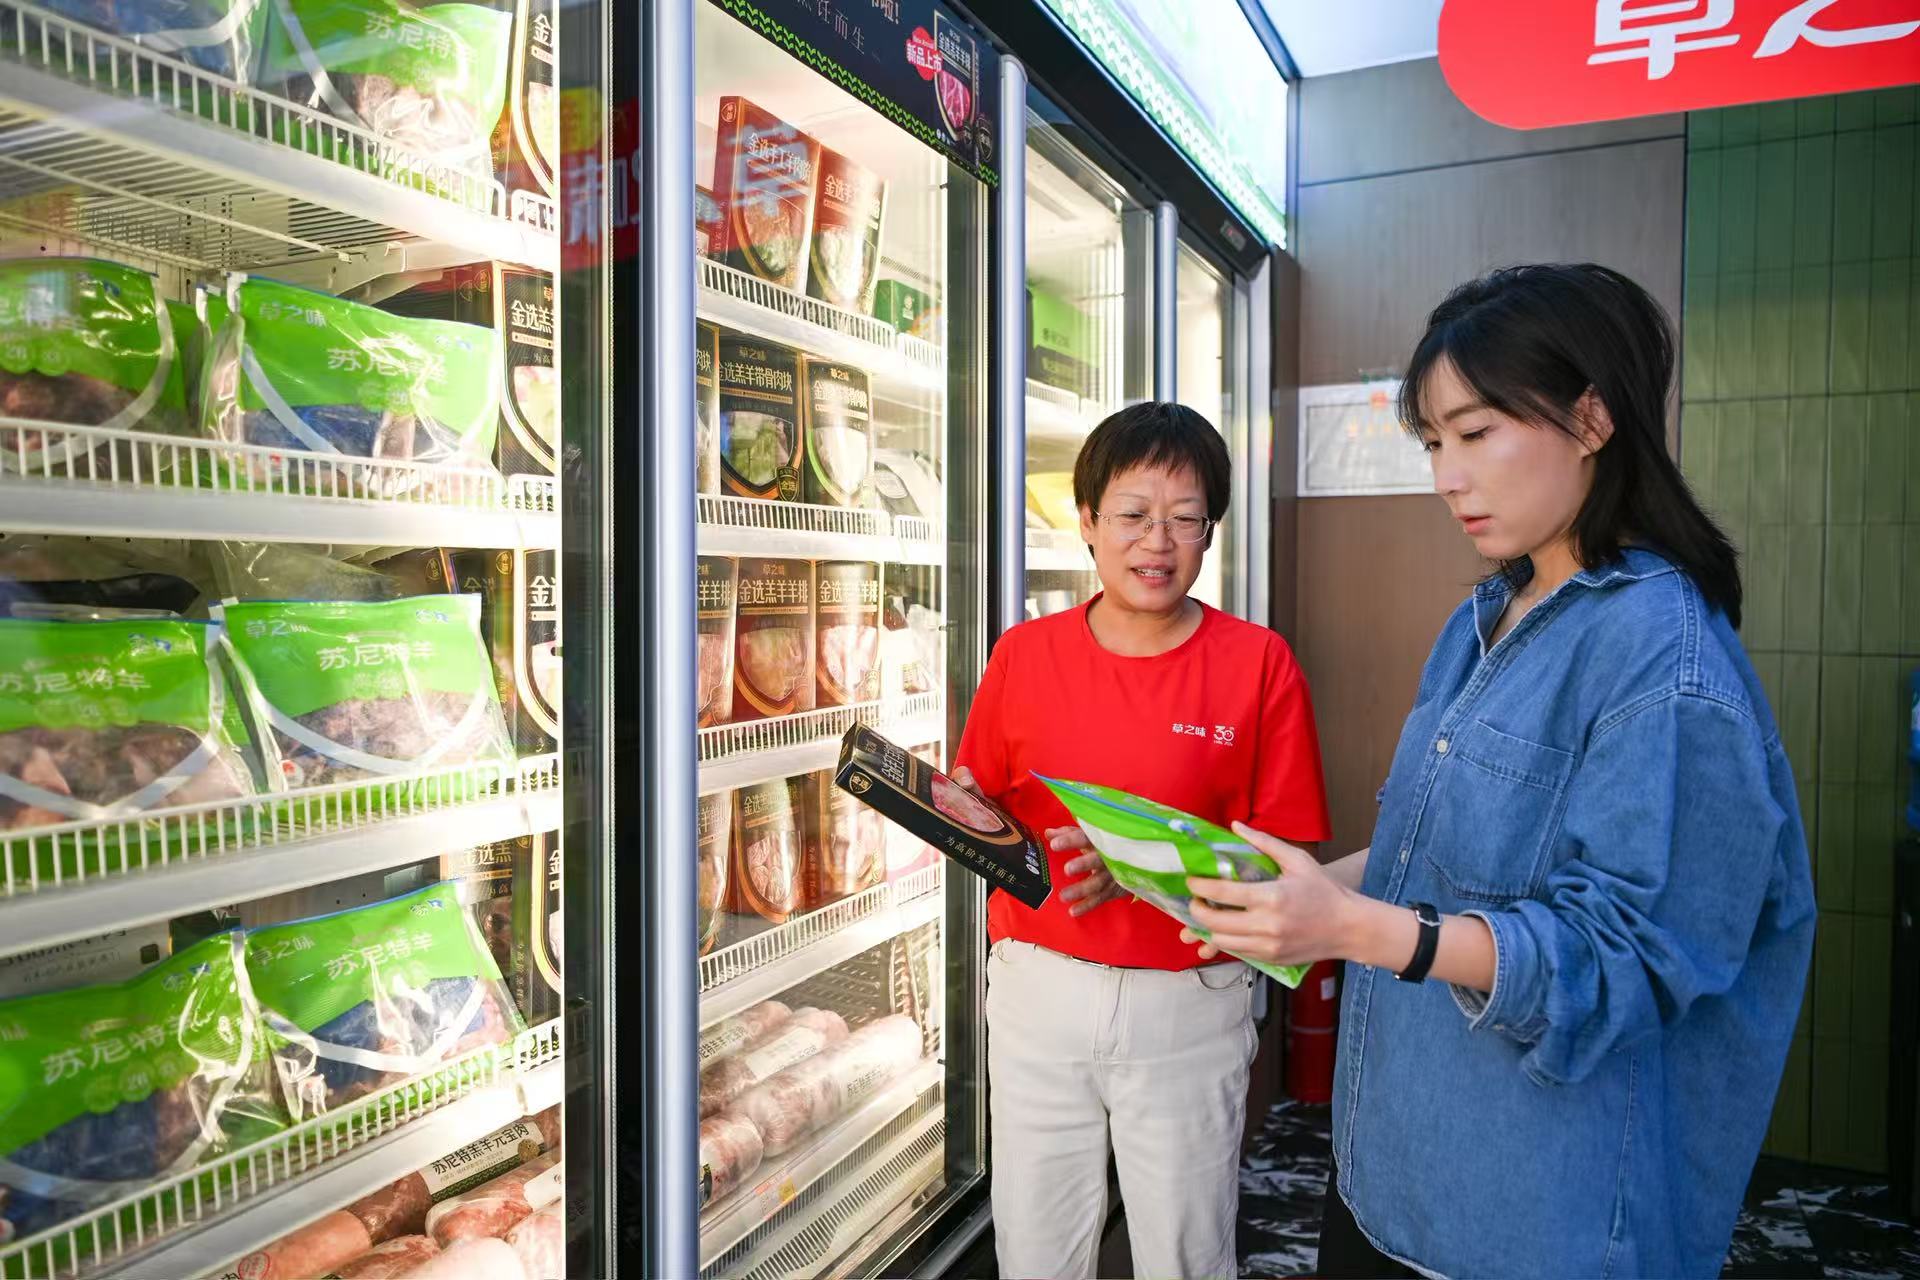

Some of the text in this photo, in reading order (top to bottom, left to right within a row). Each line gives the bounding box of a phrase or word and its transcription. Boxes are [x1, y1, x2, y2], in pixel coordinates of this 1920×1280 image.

[797, 0, 864, 55] 饪而生
[872, 0, 899, 24] 啦!
[906, 44, 943, 72] 新品上市
[530, 575, 556, 607] 金
[739, 578, 809, 605] 金选羔羊羊排
[1172, 723, 1206, 738] 草之味
[946, 836, 1018, 885] 为高阶烹饪而生
[322, 930, 434, 981] 苏尼特羊
[430, 1123, 530, 1176] 苏尼特羔羊元宝肉
